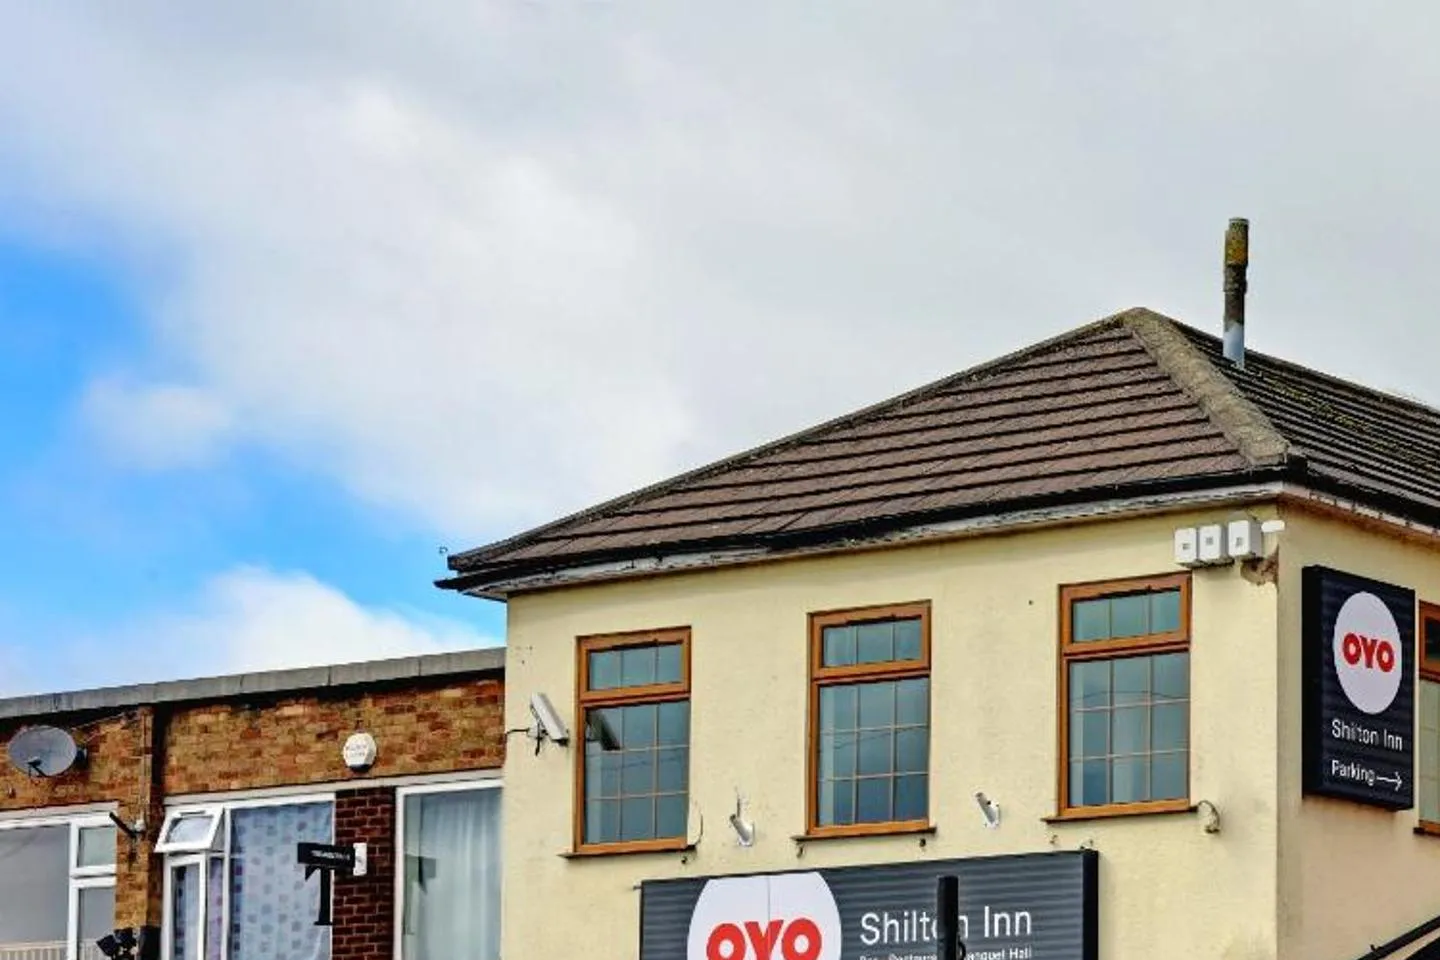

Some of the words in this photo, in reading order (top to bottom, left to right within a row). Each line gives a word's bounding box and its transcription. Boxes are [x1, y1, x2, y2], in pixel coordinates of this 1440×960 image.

[1342, 632, 1395, 673] OYO
[1332, 718, 1379, 745] Shilton
[1384, 728, 1403, 751] Inn
[1331, 759, 1376, 787] Parking
[984, 905, 1032, 938] Inn
